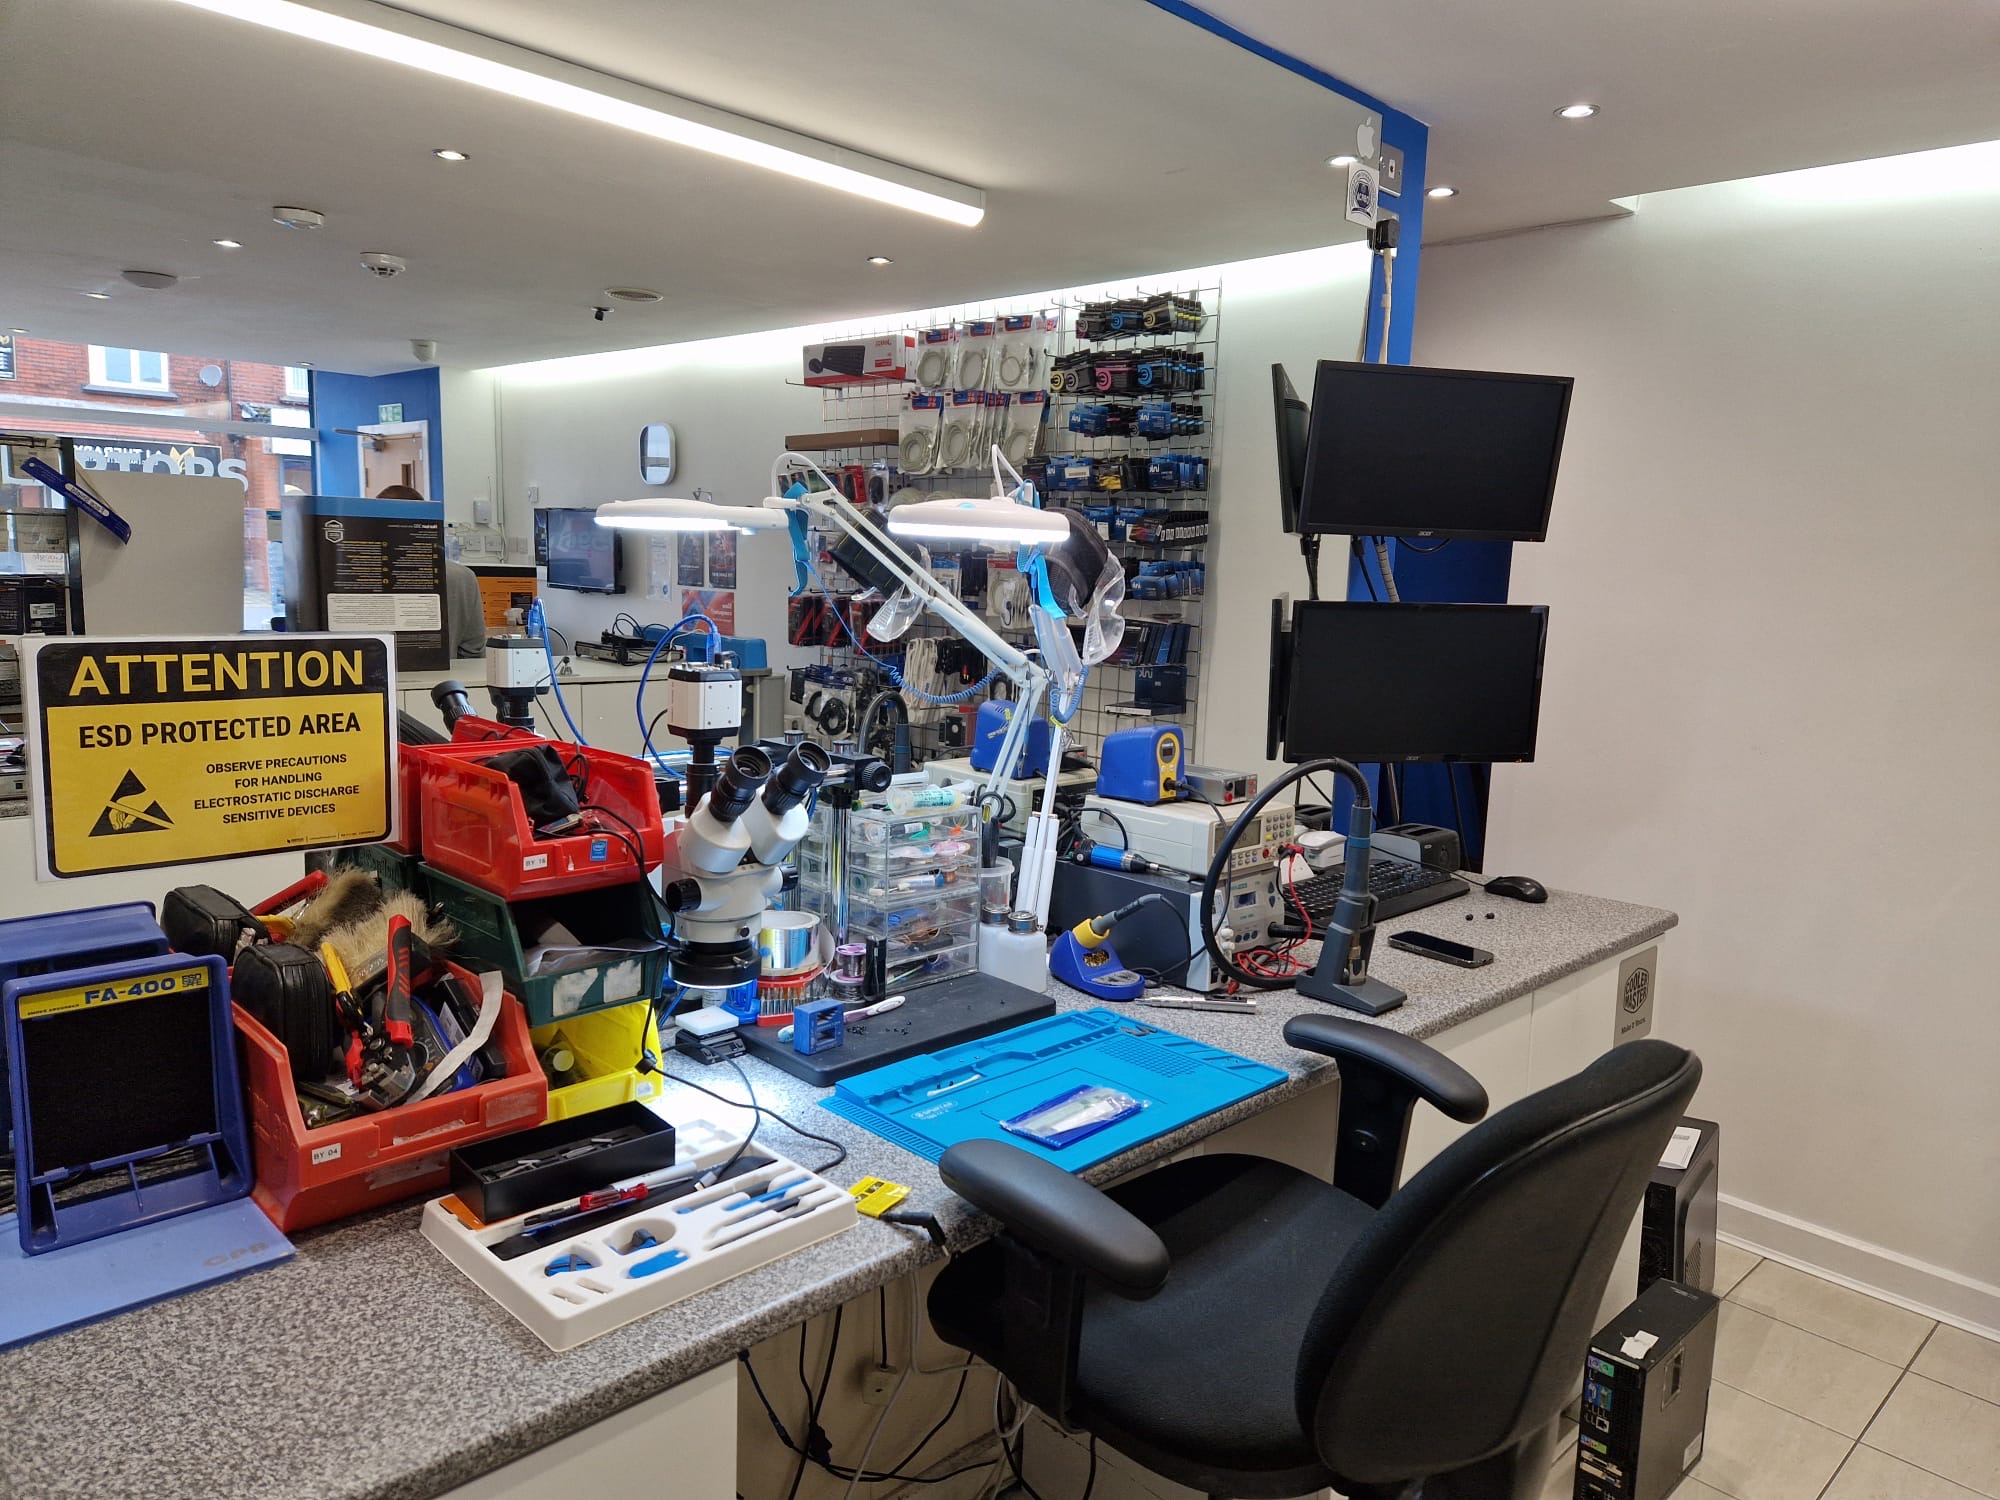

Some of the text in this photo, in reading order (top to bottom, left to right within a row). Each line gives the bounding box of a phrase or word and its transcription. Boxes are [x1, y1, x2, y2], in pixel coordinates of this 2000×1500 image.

[68, 648, 364, 698] ATTENTION
[79, 711, 361, 749] ESD PROTECTED AREA
[206, 753, 347, 774] OBSERVE PRECAUTIONS
[235, 771, 323, 789] FOR HANDLING
[194, 784, 360, 810] ELECTROSTATIC DISCHARGE
[222, 803, 336, 825] SENSITIVE DEVICES
[84, 977, 176, 1005] FA-400
[1624, 970, 1649, 994] COOLER
[1624, 985, 1648, 1010] MASTER
[313, 1147, 339, 1161] BY 04
